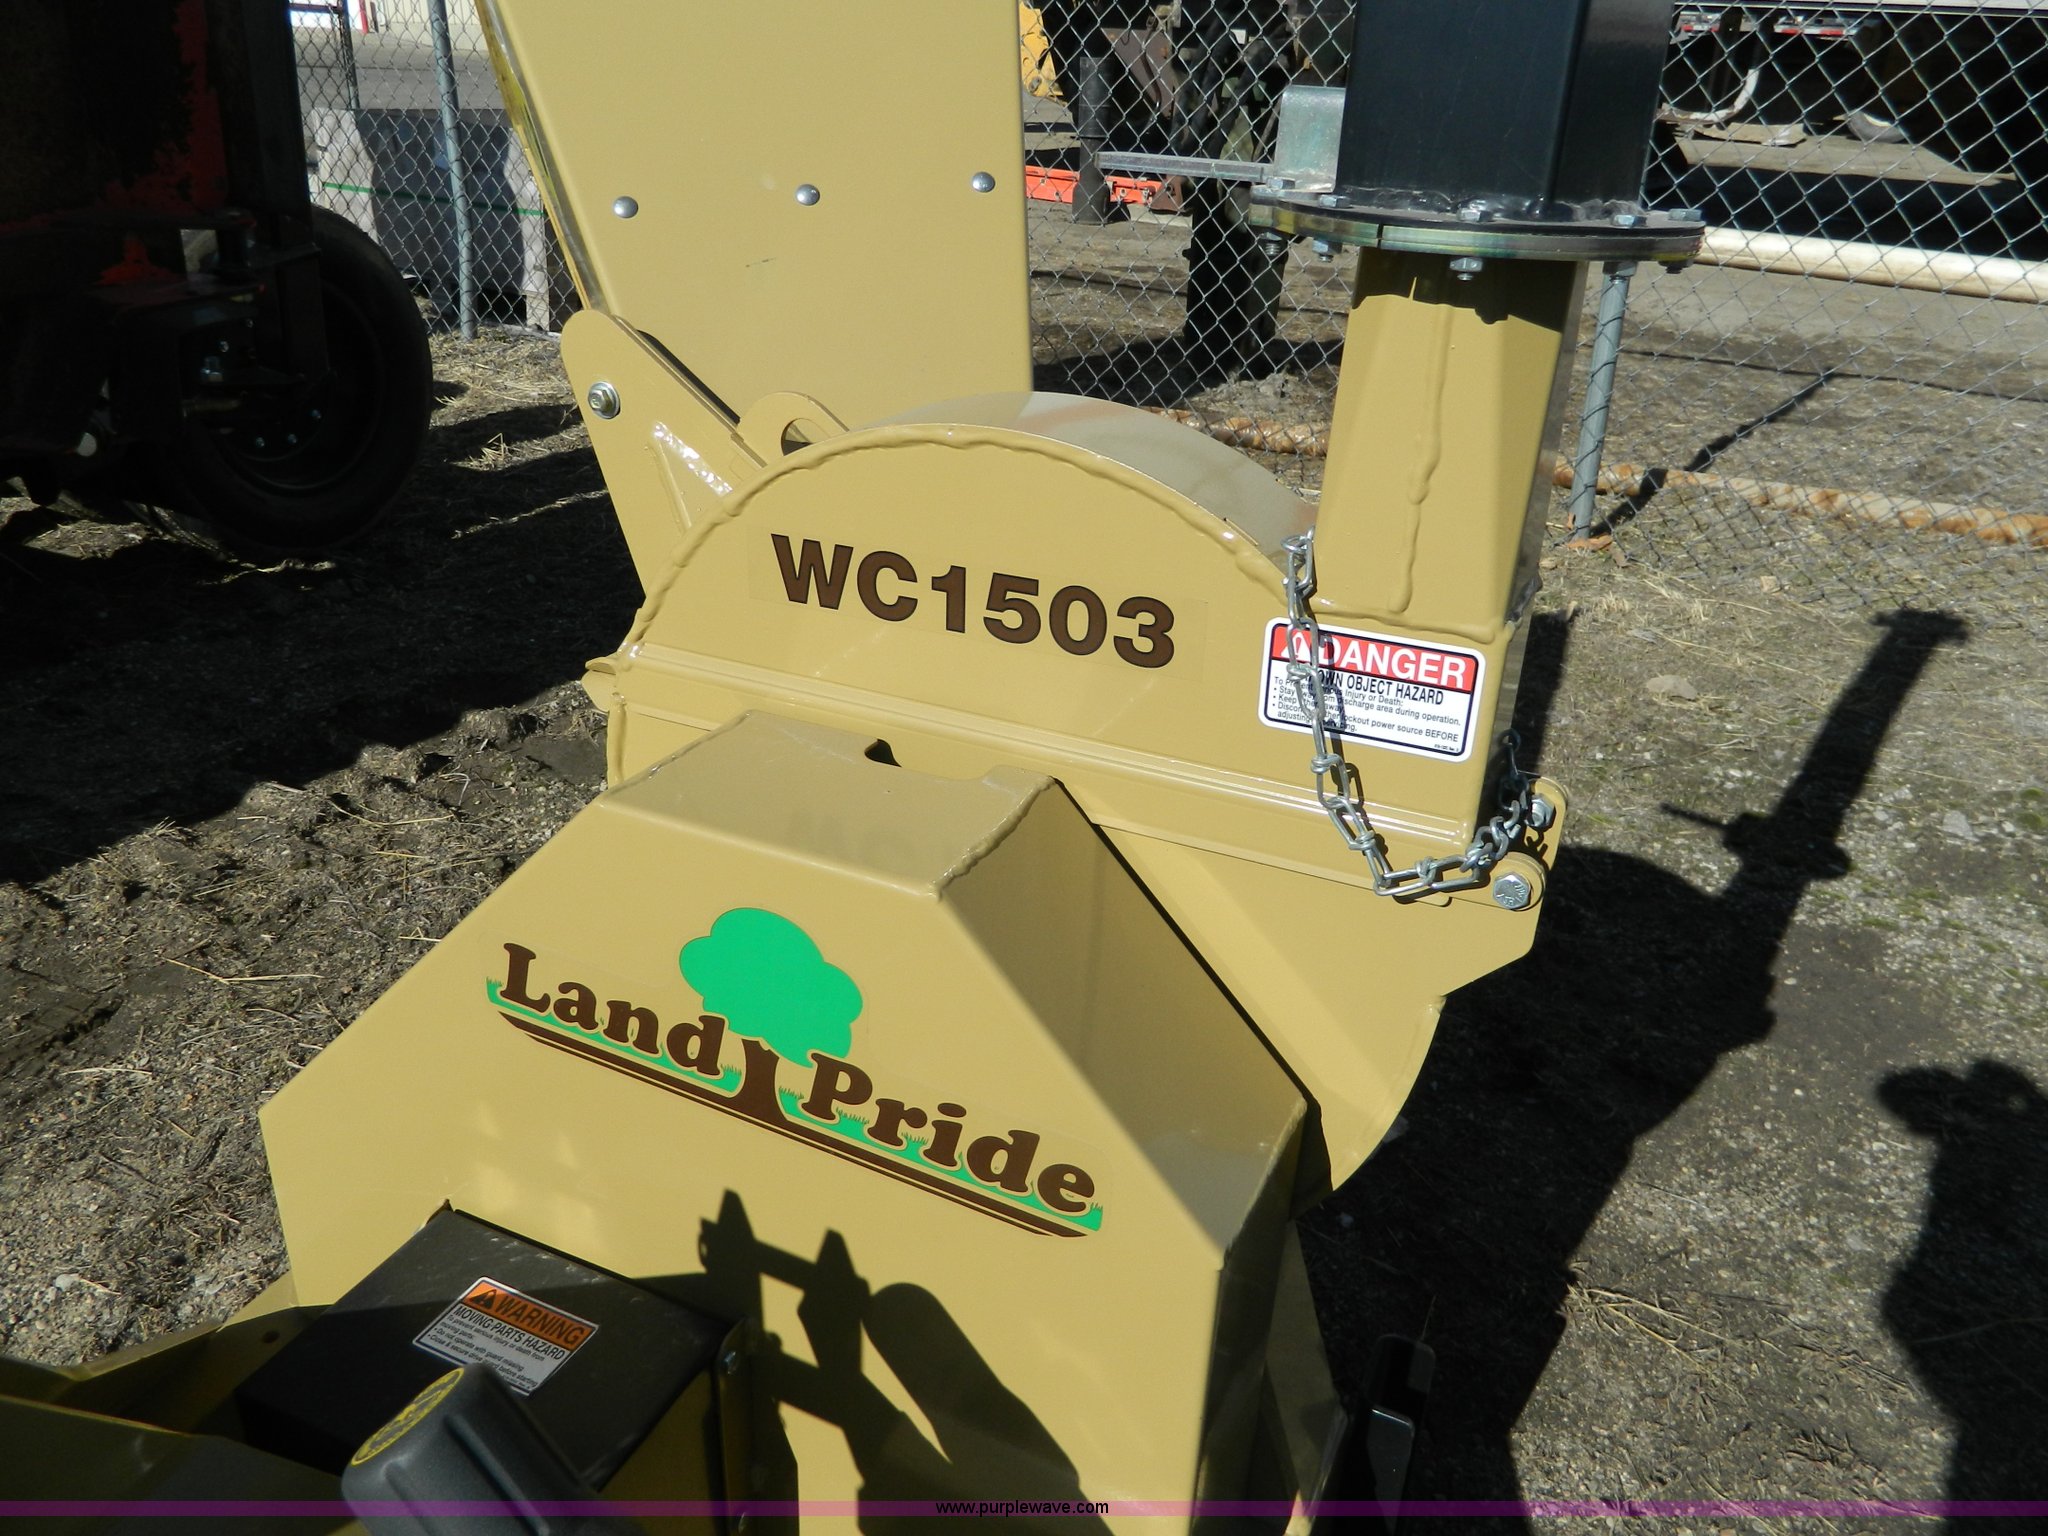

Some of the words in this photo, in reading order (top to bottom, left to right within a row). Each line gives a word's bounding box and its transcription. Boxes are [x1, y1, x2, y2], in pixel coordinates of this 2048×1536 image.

[770, 533, 1175, 669] WC1503
[1318, 634, 1467, 689] DANGER
[1278, 694, 1297, 704] Keep
[1279, 686, 1295, 696] Stay
[1376, 704, 1394, 713] area
[1395, 707, 1420, 720] during
[1421, 712, 1461, 726] operation.
[1345, 689, 1366, 701] Injury
[1368, 694, 1377, 702] or
[1378, 695, 1404, 706] Death:
[1346, 674, 1392, 696] OBJECT
[1395, 682, 1444, 705] HAZARD
[1371, 720, 1395, 731] power
[1397, 725, 1423, 736] source
[1425, 728, 1459, 742] BEFORE
[499, 942, 726, 1078] Land
[800, 1051, 1096, 1213] Pride
[453, 1306, 494, 1329] MOVING
[490, 1322, 526, 1343] PARTS
[522, 1336, 566, 1360] HAZARD
[495, 1294, 586, 1345] WARNING
